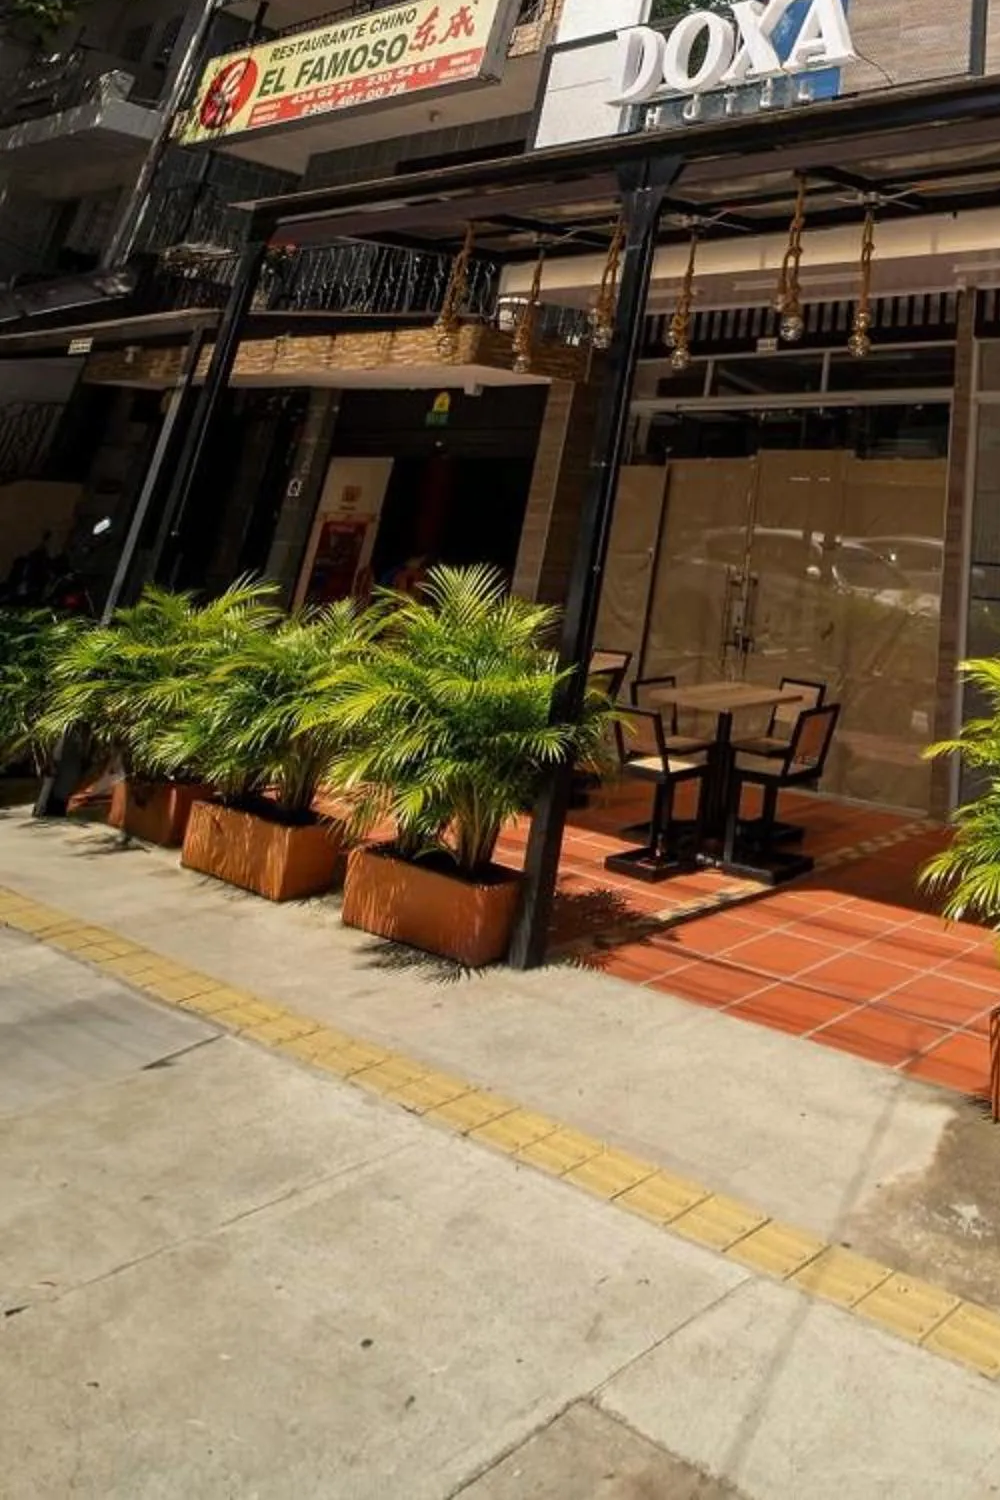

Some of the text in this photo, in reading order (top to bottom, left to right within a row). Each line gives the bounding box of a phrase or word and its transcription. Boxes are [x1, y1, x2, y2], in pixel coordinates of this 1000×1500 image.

[270, 9, 417, 62] RESTAURANTE CHINO
[257, 33, 410, 97] EL FAMOSO
[645, 82, 811, 128] HOTEL
